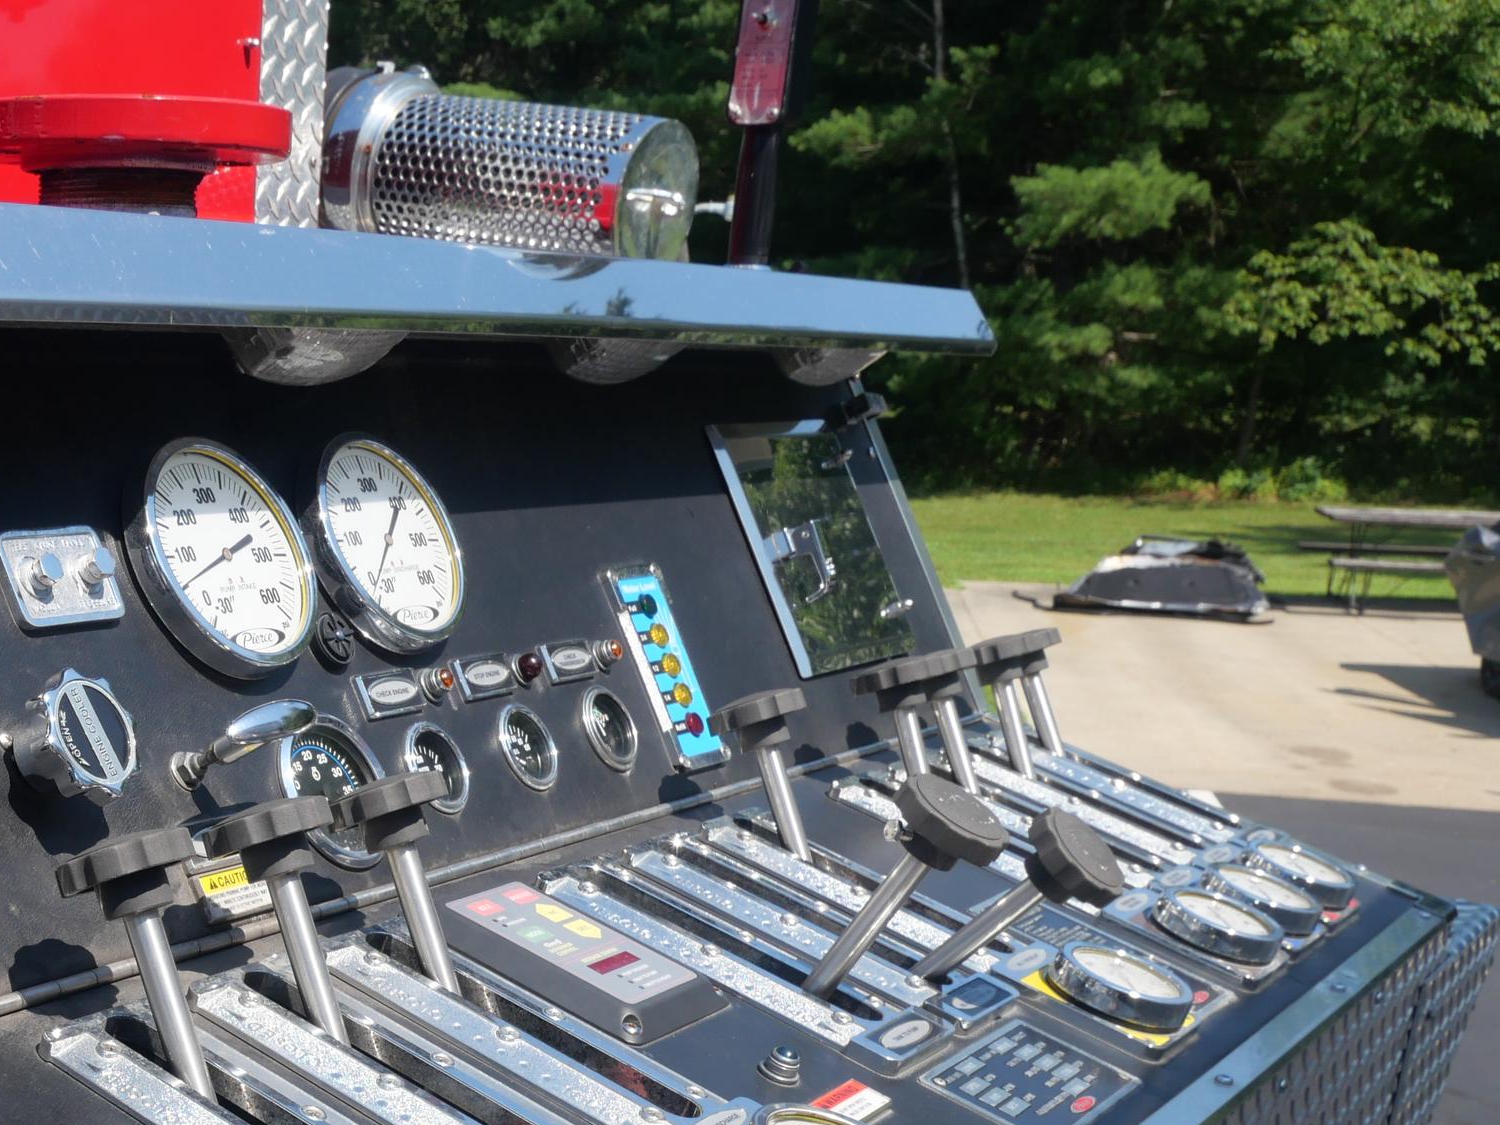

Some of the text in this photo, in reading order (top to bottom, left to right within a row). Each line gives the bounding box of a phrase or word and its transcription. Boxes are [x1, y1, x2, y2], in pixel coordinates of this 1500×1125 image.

[357, 477, 377, 492] 300
[192, 487, 216, 504] 300
[341, 497, 361, 512] 200
[389, 496, 406, 511] 400
[173, 509, 197, 526] 200
[228, 507, 249, 524] 400
[343, 531, 362, 546] 100
[409, 532, 427, 547] 500
[175, 545, 197, 563] 100
[251, 547, 272, 563] 500
[417, 570, 435, 585] 600
[202, 590, 211, 606] 0
[260, 587, 280, 605] 600
[402, 608, 429, 622] Pierce
[243, 632, 273, 648] Pierce
[375, 687, 410, 698] CHECK ENGINE
[70, 687, 118, 777] ENGINE COOLER
[301, 750, 313, 761] 20
[316, 753, 328, 764] 25
[293, 761, 303, 771] 15
[331, 766, 343, 778] 30
[342, 785, 354, 795] 35
[217, 870, 248, 887] CAUTIO
